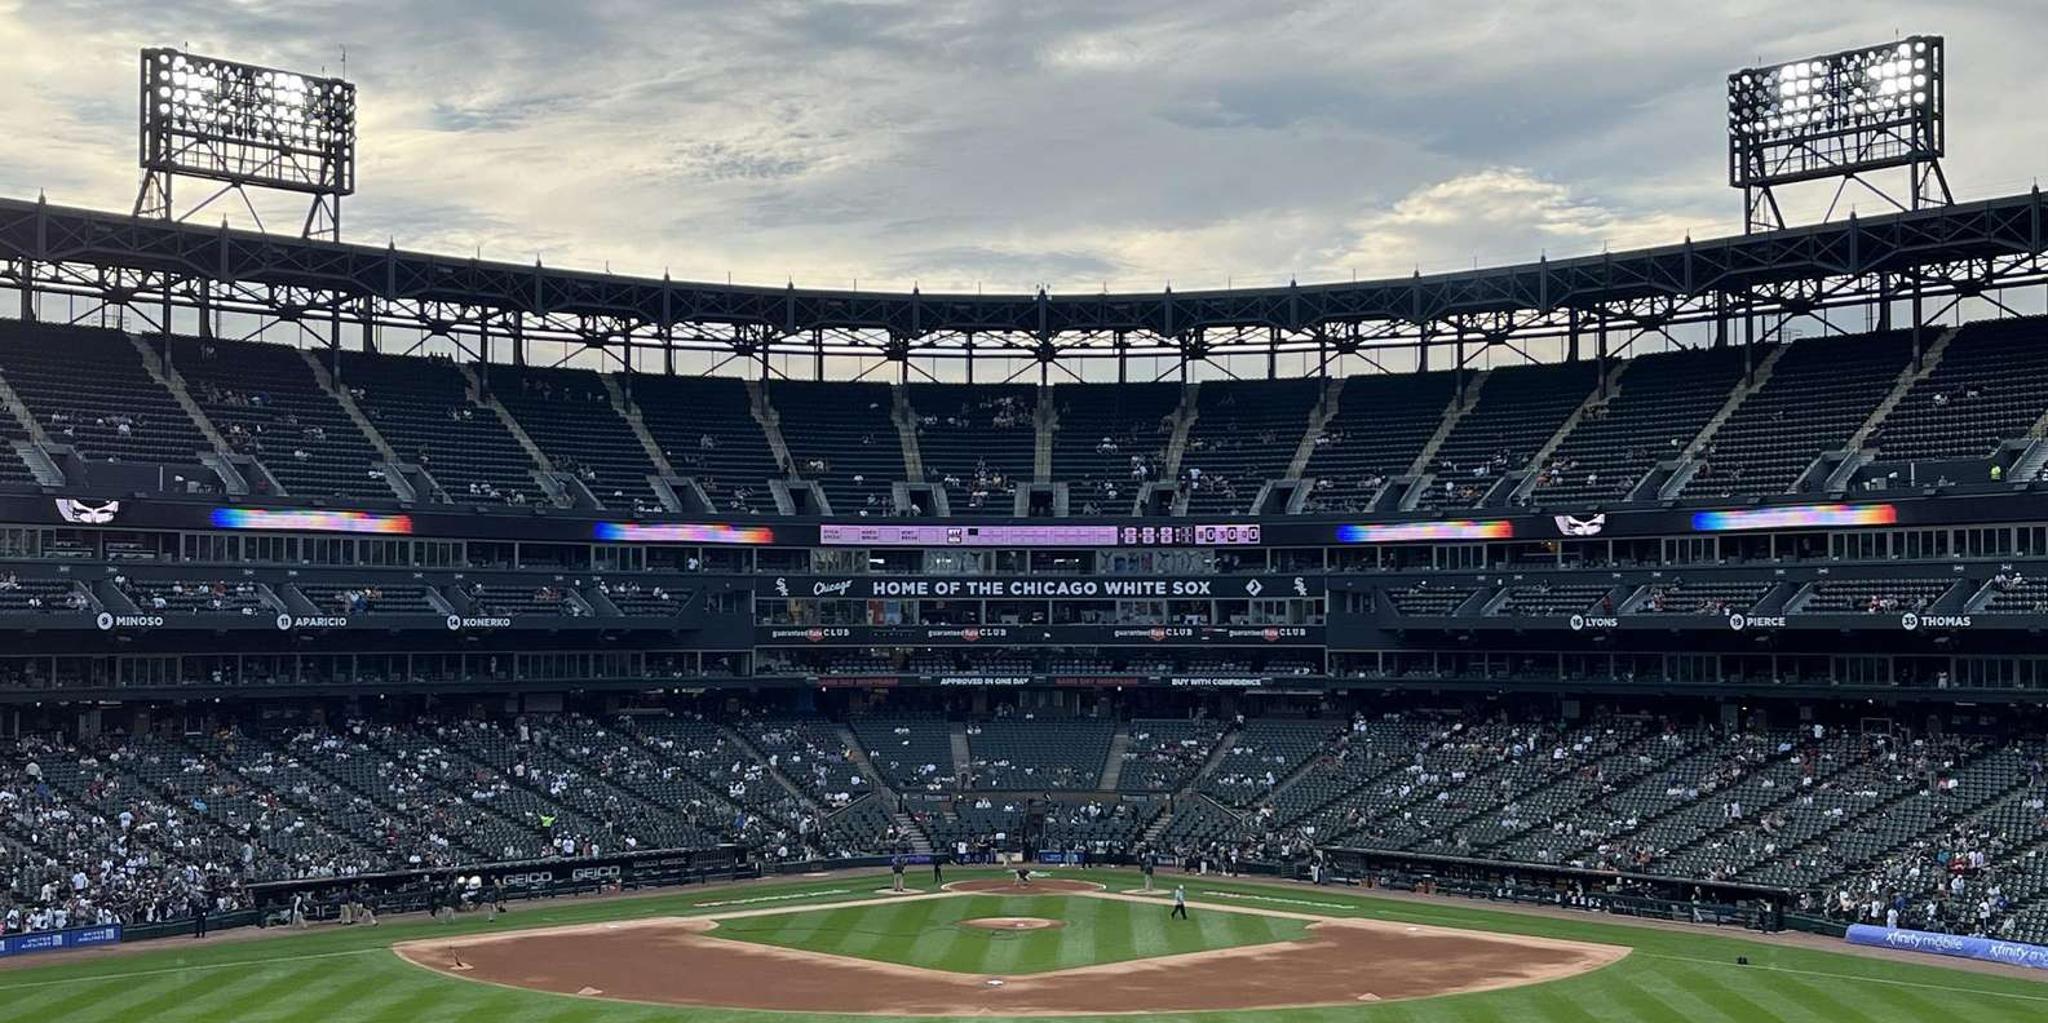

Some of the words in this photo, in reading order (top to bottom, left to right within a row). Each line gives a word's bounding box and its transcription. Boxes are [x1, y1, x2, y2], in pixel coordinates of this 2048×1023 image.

[813, 579, 853, 596] Chicago
[872, 581, 929, 595] HOME
[934, 581, 961, 595] OF
[966, 581, 1004, 595] THE
[1010, 581, 1098, 595] CHICAGO
[1104, 581, 1167, 595] WHITE
[1172, 581, 1211, 595] SOX
[115, 616, 164, 626] MINOSO
[294, 617, 347, 626] APARICIO
[462, 618, 511, 627] KONERKO
[1585, 618, 1618, 627] LYONS
[1746, 617, 1786, 626] PIERCE
[1920, 616, 1972, 626] THOMAS
[940, 677, 984, 685] APPROVED
[1171, 678, 1190, 686] BUY
[572, 865, 621, 882] GEICO
[503, 871, 552, 887] GEICO
[1886, 931, 1921, 948] xfinity
[1923, 935, 1963, 951] mobile
[1990, 942, 2030, 961] xfinity
